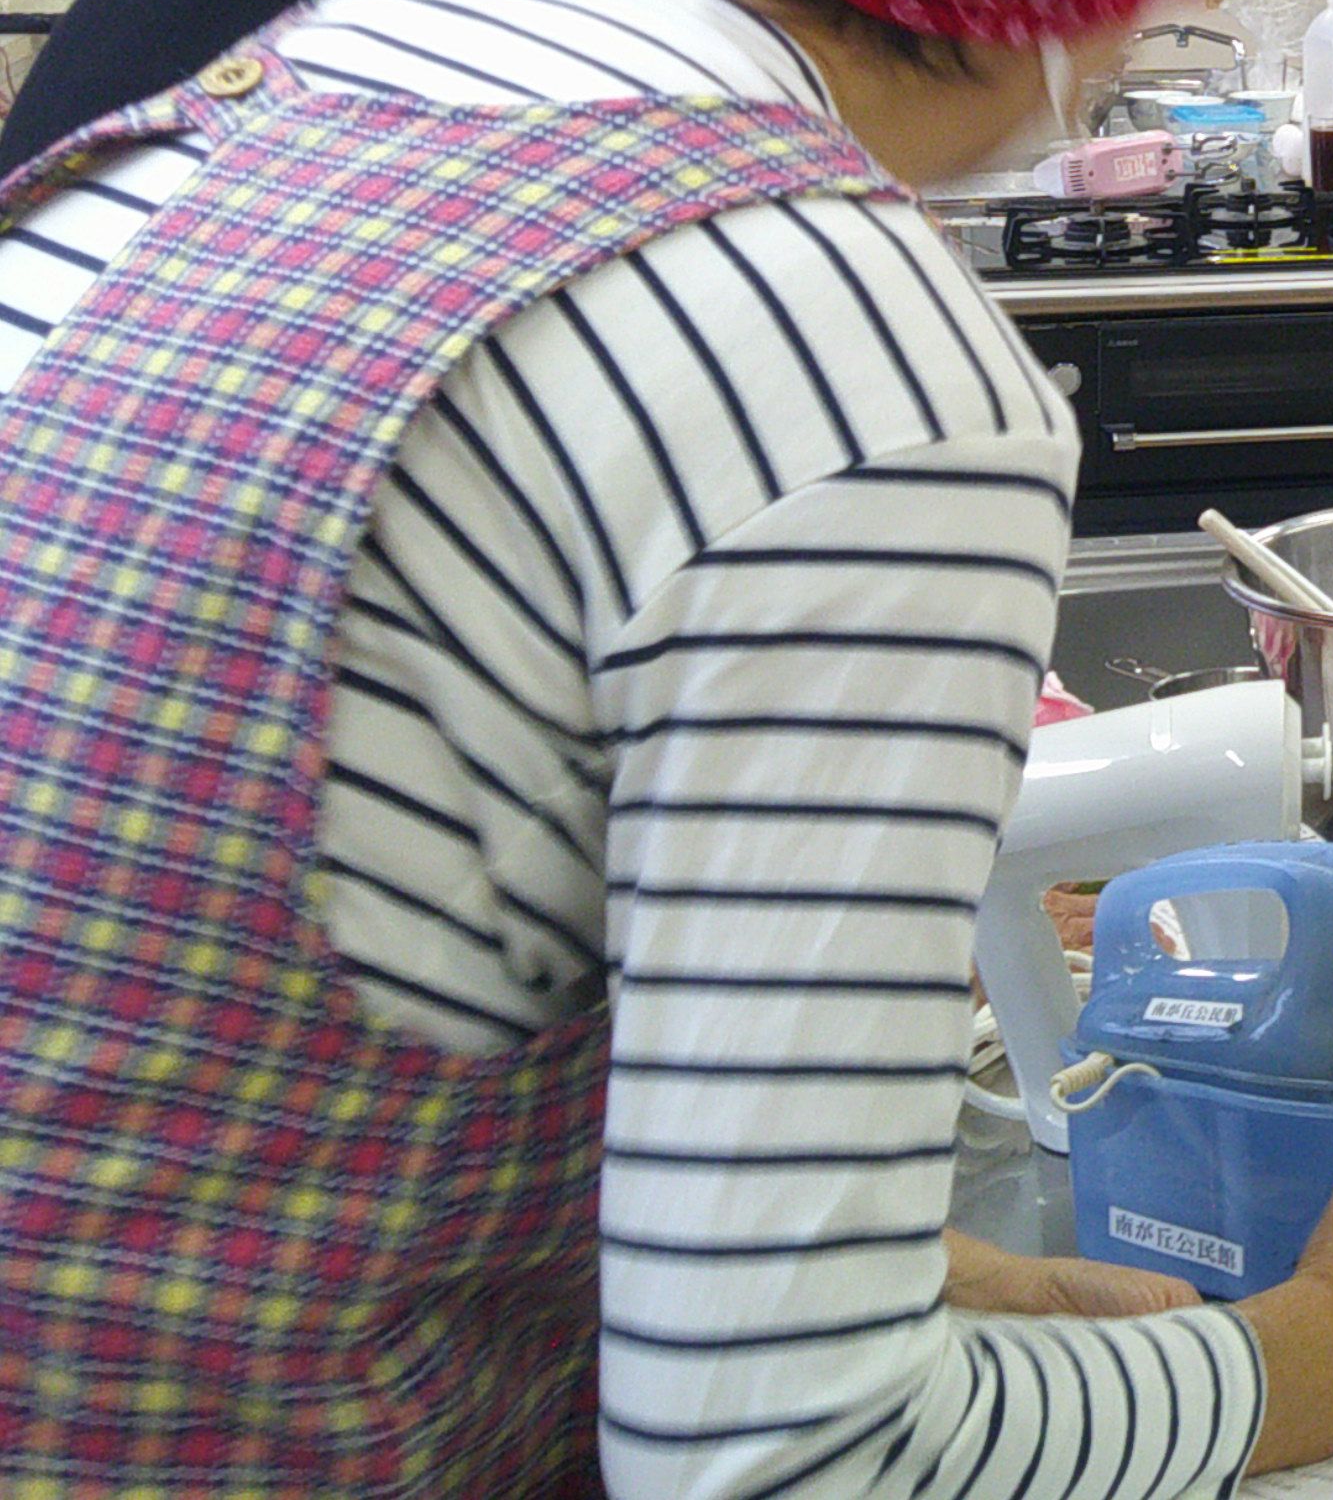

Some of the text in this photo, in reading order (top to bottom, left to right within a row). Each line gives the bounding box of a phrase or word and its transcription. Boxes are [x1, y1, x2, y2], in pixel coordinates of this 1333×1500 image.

[1150, 1001, 1239, 1023] 南が丘公民館
[1115, 1213, 1237, 1271] 南が丘公民館
